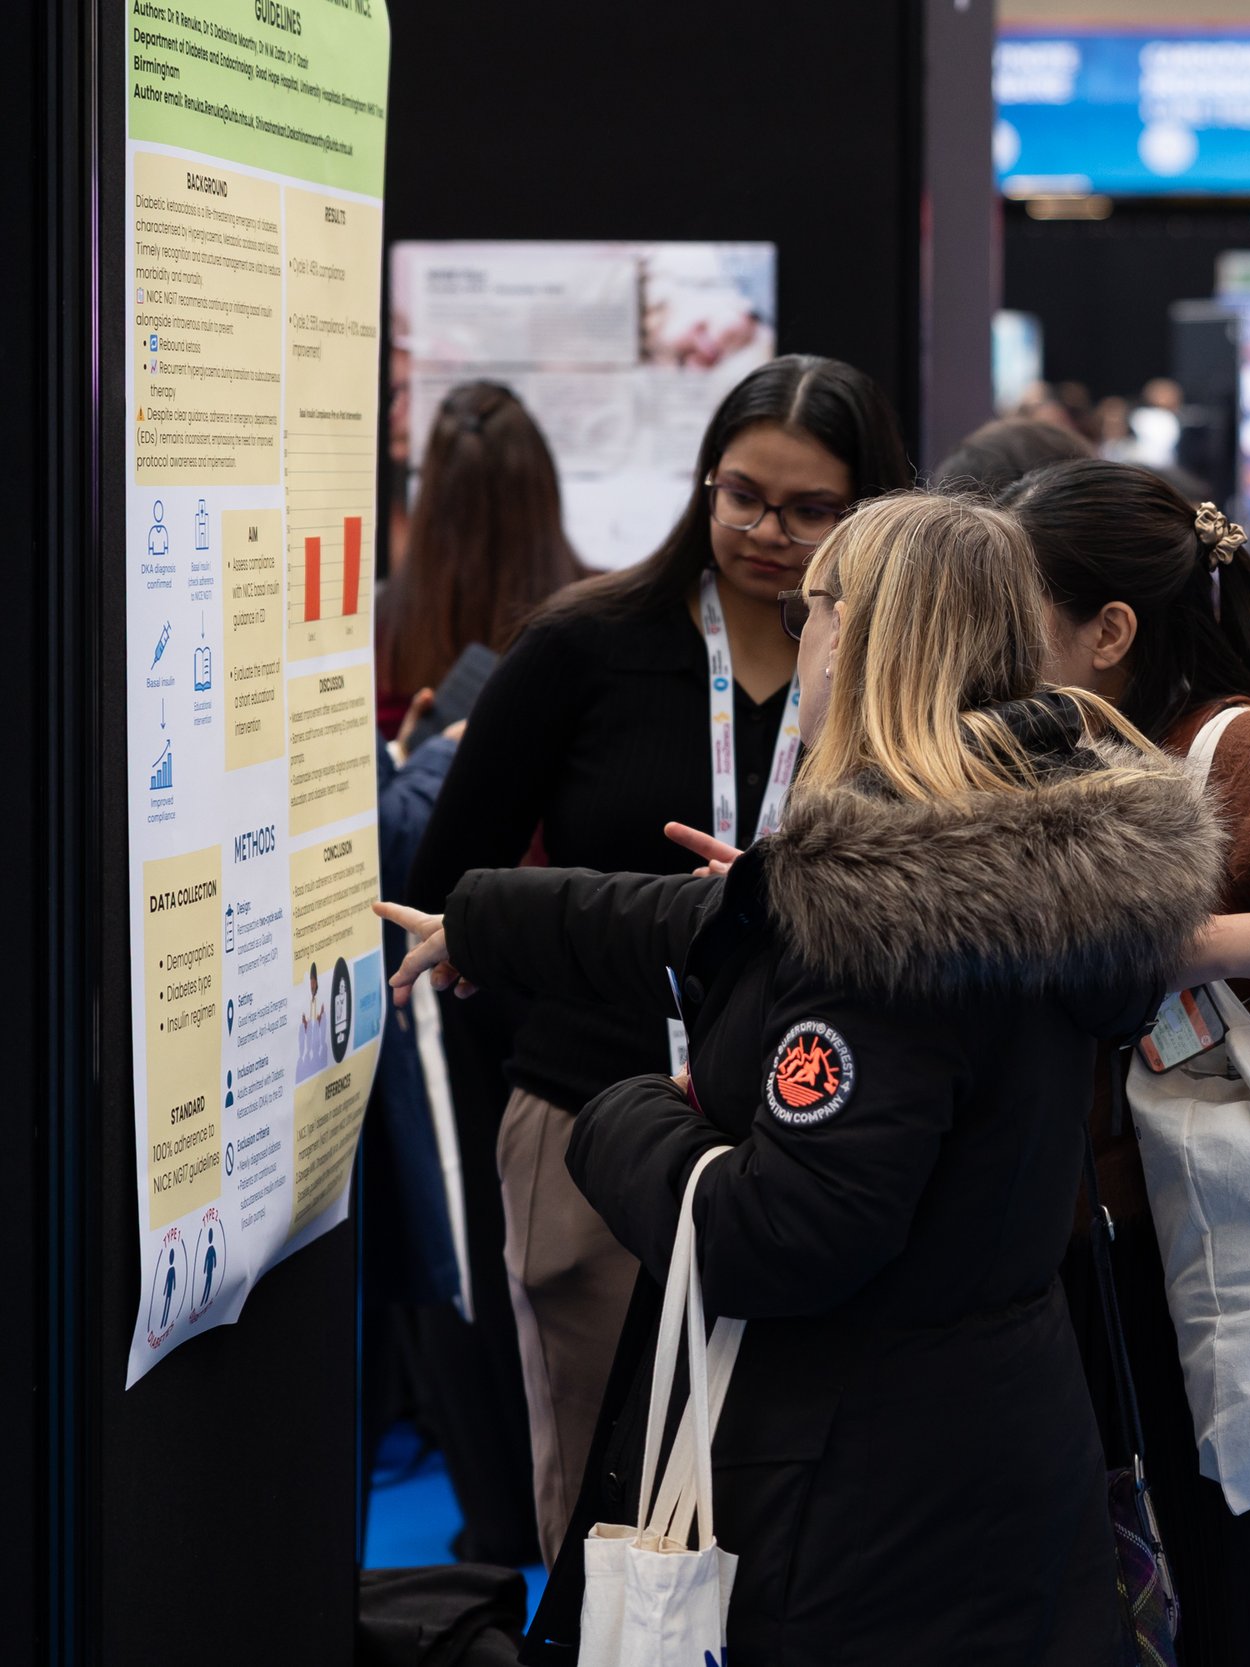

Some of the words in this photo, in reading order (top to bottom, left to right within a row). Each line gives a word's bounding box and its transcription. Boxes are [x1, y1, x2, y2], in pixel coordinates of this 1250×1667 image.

[134, 0, 166, 21] Authors:
[168, 7, 175, 24] Dr
[176, 10, 180, 26] R
[204, 19, 210, 34] Dr
[255, 0, 301, 36] GUIDELINES
[134, 28, 178, 52] Department
[179, 40, 184, 54] of
[186, 41, 208, 62] Diabetes
[210, 51, 219, 64] and
[134, 55, 180, 80] Birmingham
[134, 84, 162, 103] Author
[164, 93, 182, 108] email:
[187, 172, 228, 197] BACKGROUND
[136, 195, 164, 210] Diabetic
[324, 206, 346, 226] RESULTS
[136, 218, 180, 236] characterised
[136, 242, 160, 260] Timely
[162, 247, 190, 262] recognition
[136, 266, 170, 284] morbidity
[171, 269, 182, 282] and
[146, 289, 162, 304] NICE
[136, 313, 172, 330] alongside
[160, 338, 184, 352] Rebound
[160, 361, 186, 374] Recurrent
[150, 384, 176, 401] therapy
[148, 408, 173, 424] Despite
[174, 409, 187, 421] clear
[137, 427, 158, 446] (EDs)
[160, 432, 184, 444] remains
[137, 454, 168, 471] protocol
[248, 526, 258, 542] AIM
[141, 564, 154, 574] DKA
[154, 562, 176, 576] diagnosis
[232, 558, 248, 572] Assess
[249, 555, 274, 574] compliance
[147, 579, 172, 589] confirmed
[243, 582, 254, 598] NICE
[254, 582, 266, 596] basal
[266, 580, 280, 596] insulin
[233, 611, 254, 631] guidance
[234, 664, 254, 681] Evaluate
[262, 660, 275, 678] impact
[146, 678, 160, 688] Basal
[162, 676, 176, 687] insulin
[319, 675, 344, 694] DISCUSSION
[239, 692, 250, 708] short
[250, 687, 275, 705] educational
[234, 718, 261, 736] intervention
[151, 796, 174, 809] Improved
[148, 810, 176, 824] compliance
[234, 824, 275, 864] METHODS
[324, 839, 352, 862] CONCLUSION
[150, 891, 176, 912] DATA
[178, 879, 216, 906] COLLECTION
[237, 900, 251, 915] Design:
[167, 941, 214, 971] Demographics
[167, 980, 197, 1002] Diabetes
[198, 974, 212, 996] type
[238, 992, 253, 1009] Setting:
[168, 1010, 190, 1032] Insulin
[191, 1003, 216, 1028] regimen
[824, 1028, 853, 1079] EVEREST
[237, 1061, 254, 1080] Inclusion
[256, 1054, 269, 1072] criteria
[325, 1072, 351, 1101] REFERENCES
[171, 1096, 205, 1125] STANDARD
[793, 1094, 844, 1123] COMPANY
[153, 1140, 172, 1163] 100%
[174, 1128, 208, 1154] adherence
[208, 1122, 214, 1138] to
[237, 1133, 255, 1152] Exclusion
[256, 1124, 270, 1143] criteria
[154, 1171, 172, 1194] NICE
[189, 1151, 220, 1184] guidelines
[202, 1207, 215, 1227] TYPE
[163, 1228, 178, 1248] TYPE
